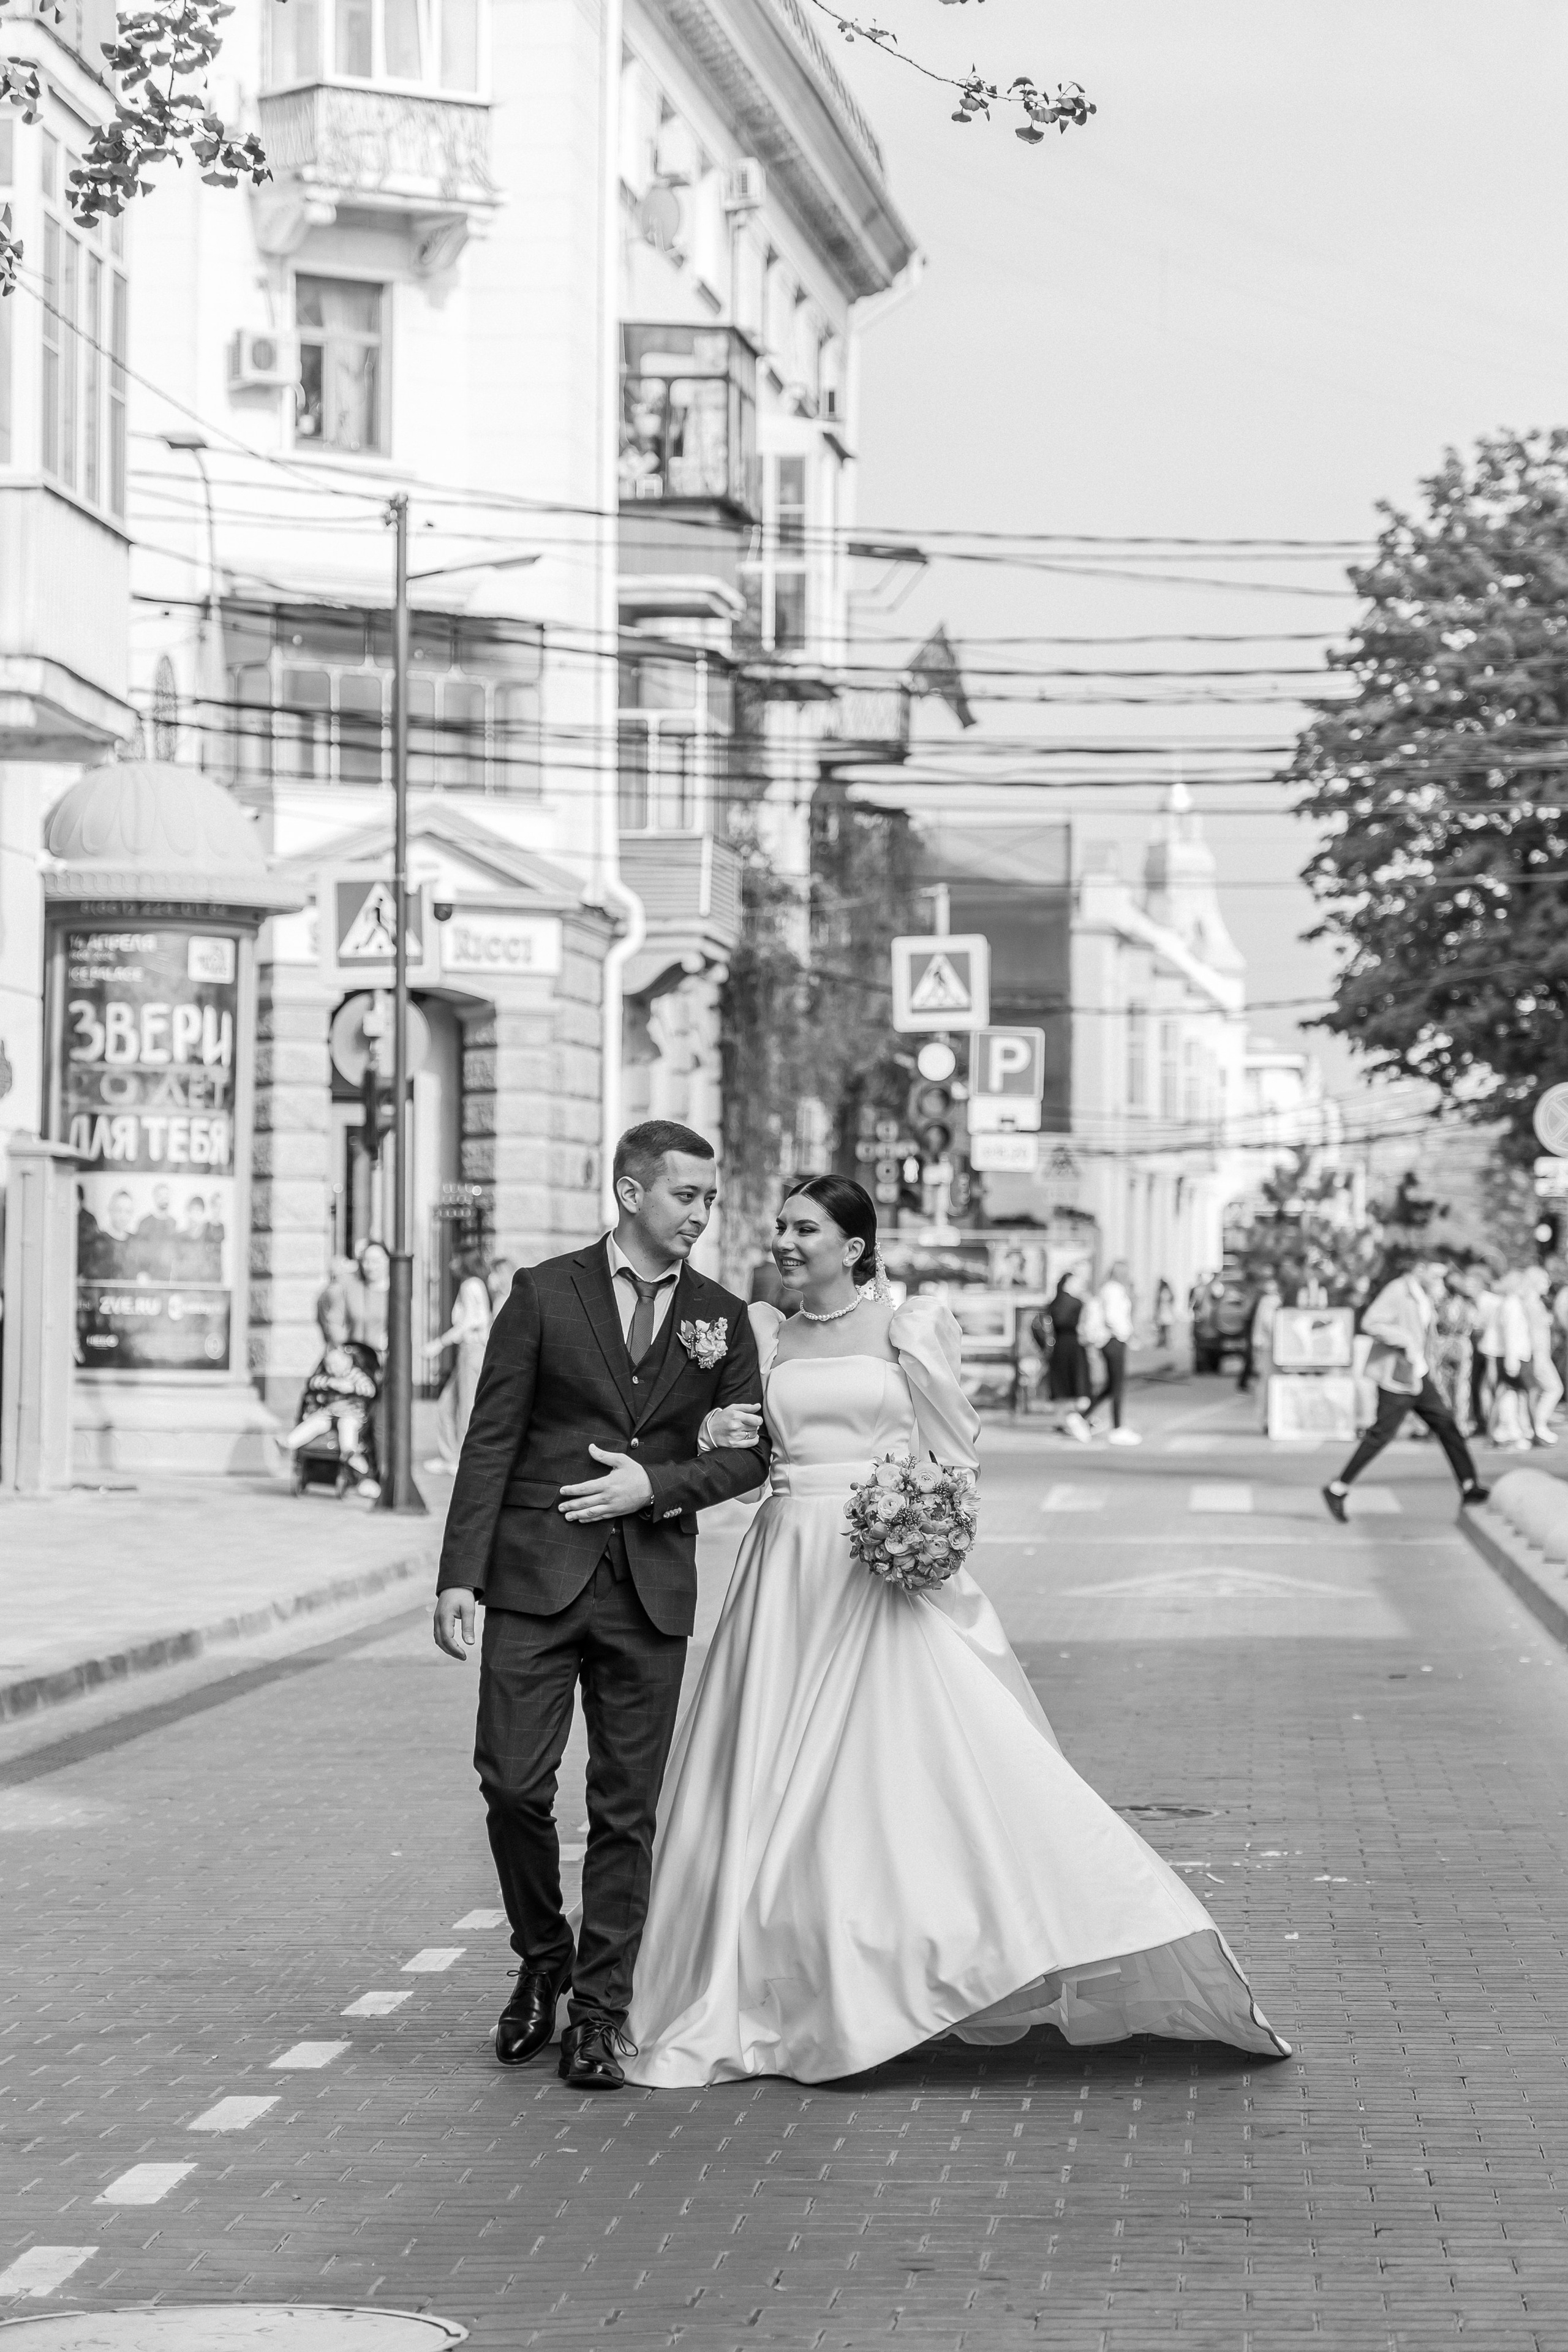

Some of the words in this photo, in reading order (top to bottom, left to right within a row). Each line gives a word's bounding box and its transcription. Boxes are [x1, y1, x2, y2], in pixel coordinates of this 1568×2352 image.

[68, 1000, 233, 1067] ЗВЕРИ
[989, 1035, 1032, 1093] P
[140, 1115, 230, 1166] ТЕБЯ
